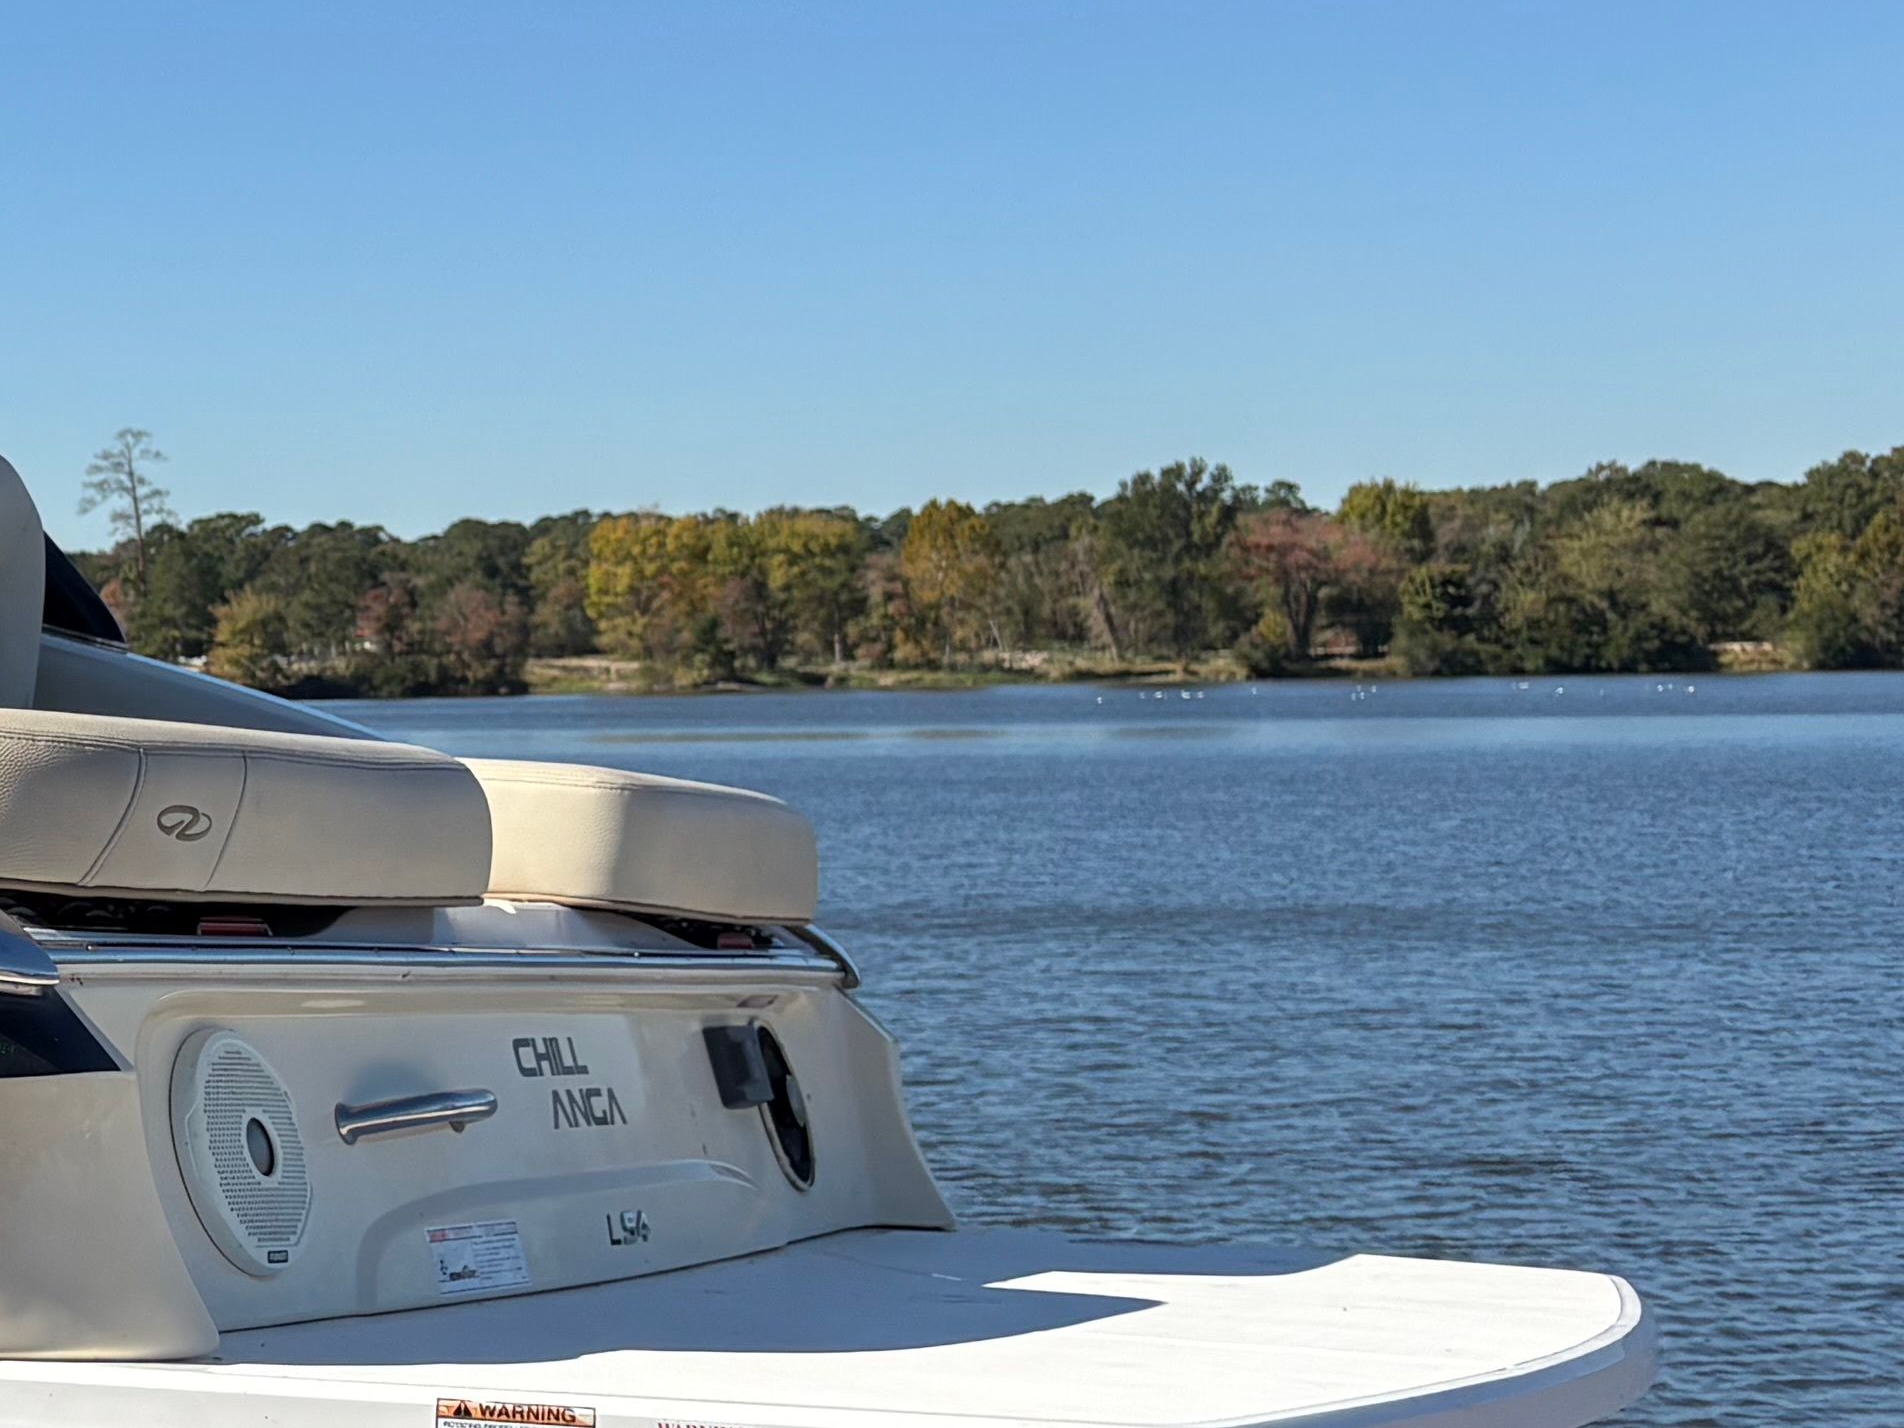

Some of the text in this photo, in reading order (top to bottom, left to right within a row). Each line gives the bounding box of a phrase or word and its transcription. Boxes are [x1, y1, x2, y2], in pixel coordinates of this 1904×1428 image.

[512, 1037, 589, 1077] CHILL
[552, 1087, 627, 1129] ANGA
[479, 1403, 577, 1423] WARNING
